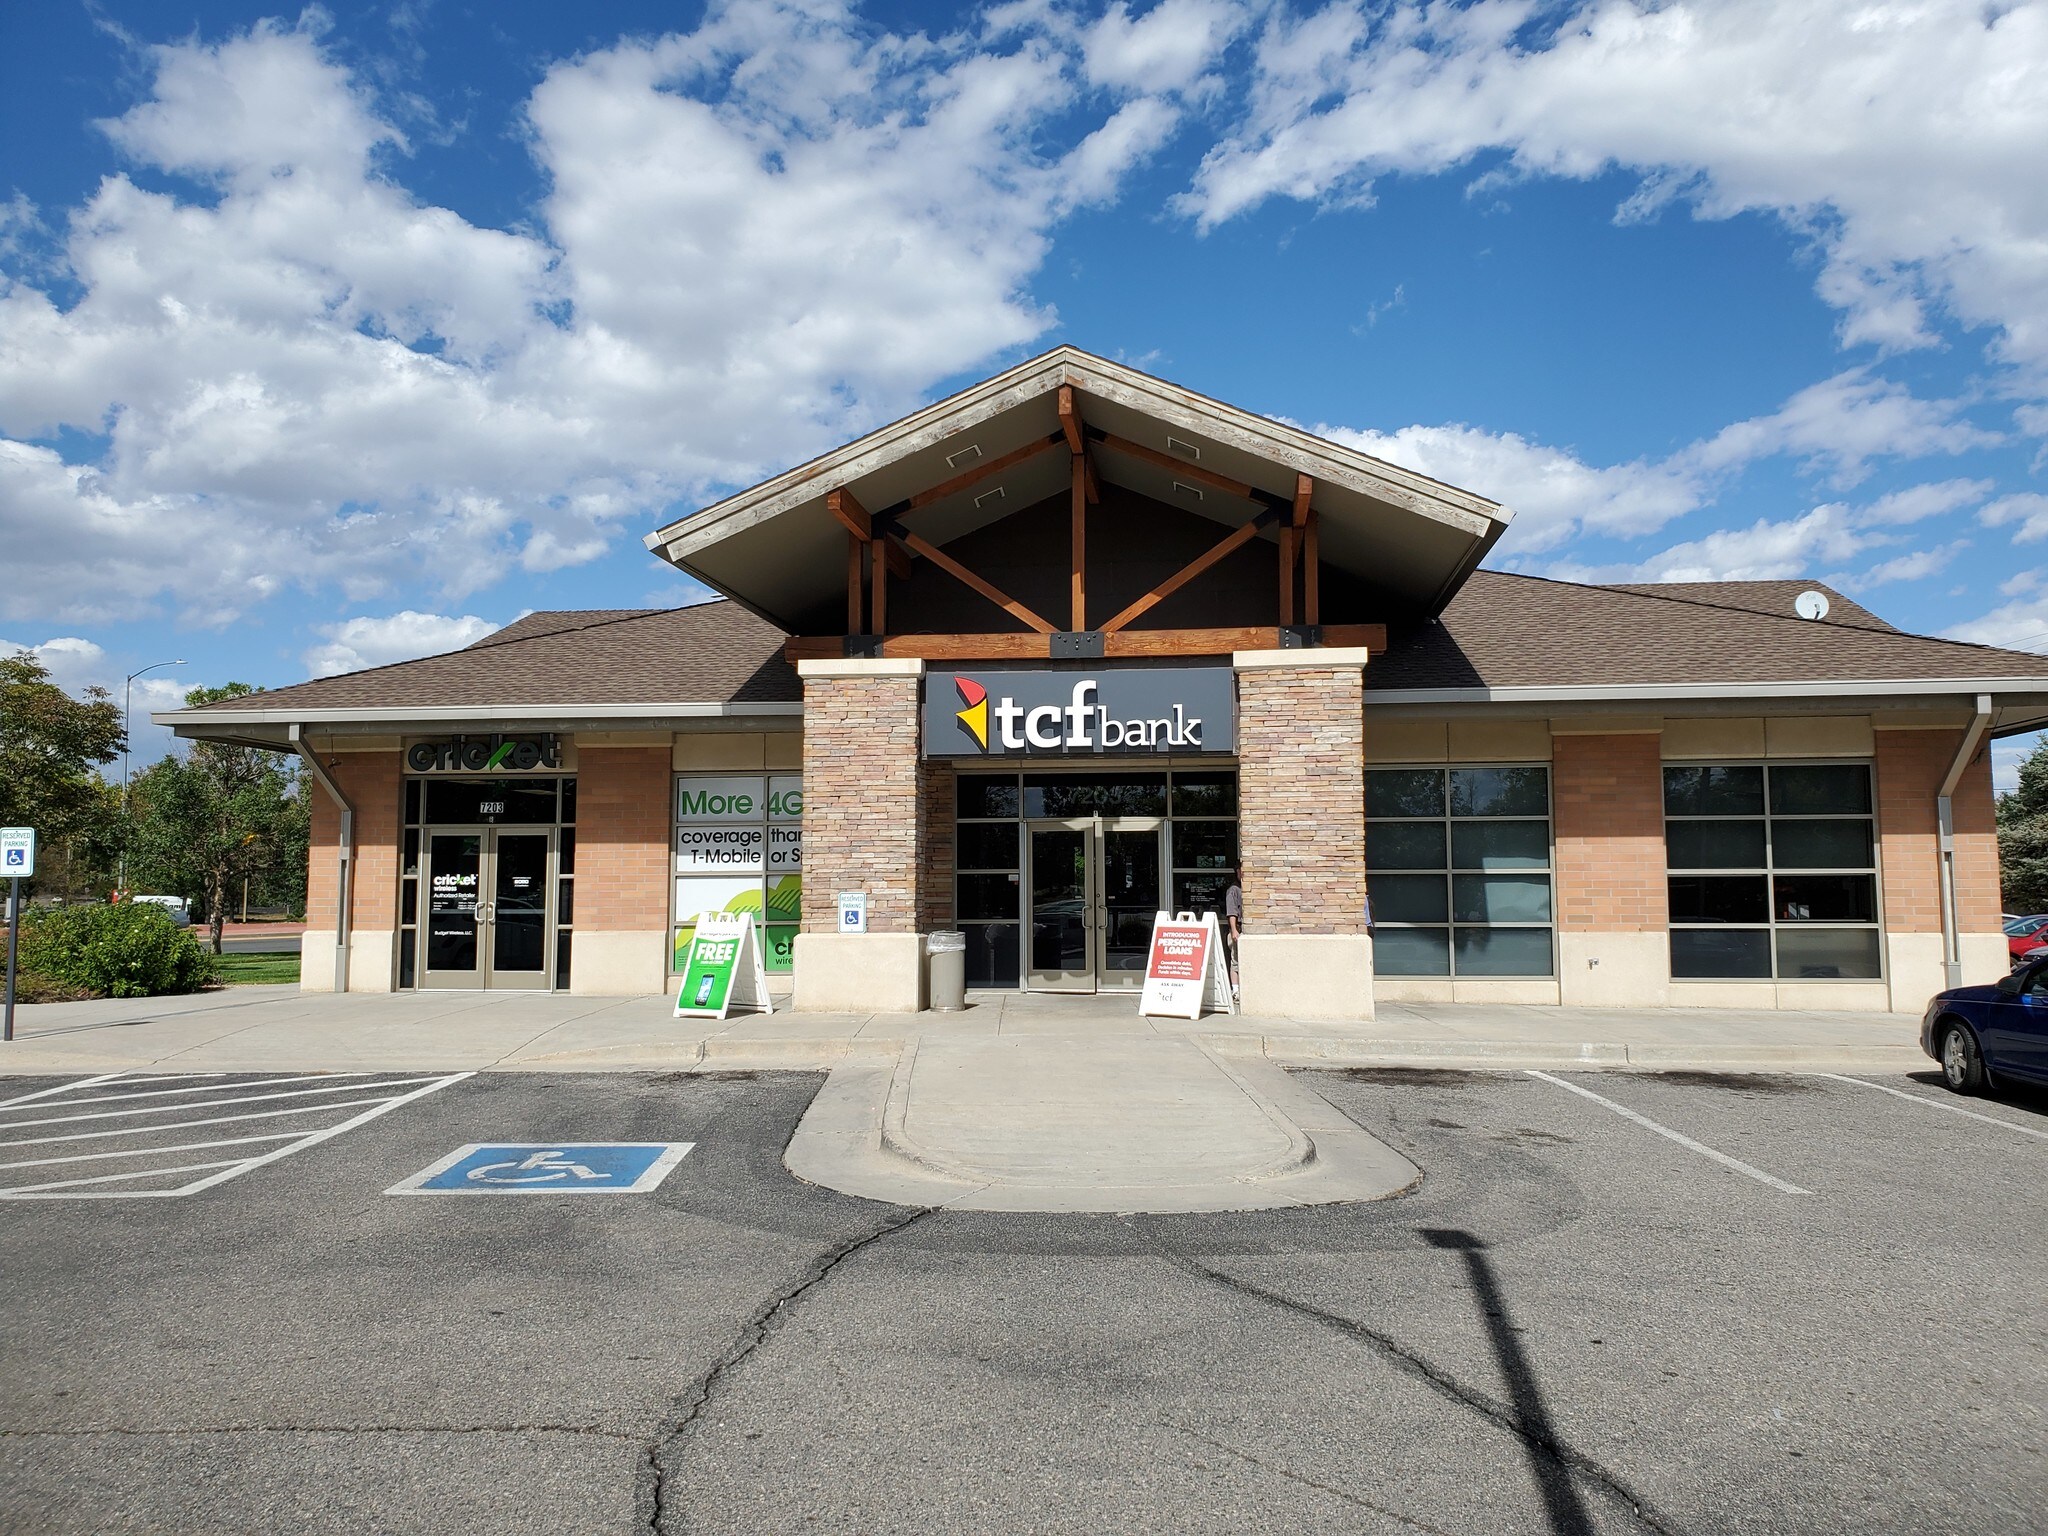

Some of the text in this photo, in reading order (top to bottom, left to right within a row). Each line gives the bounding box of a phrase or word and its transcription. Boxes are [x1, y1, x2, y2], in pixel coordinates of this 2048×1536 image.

[995, 680, 1202, 749] tcf bank
[408, 733, 560, 771] cricket
[481, 802, 503, 813] 7203
[682, 790, 804, 815] More 4G
[681, 831, 762, 847] coverage
[691, 849, 762, 863] T-Mobile
[771, 851, 787, 863] or
[433, 874, 477, 885] cricket
[1157, 938, 1202, 948] PERSONAL
[1163, 946, 1193, 955] LOANS
[695, 943, 735, 960] FREE
